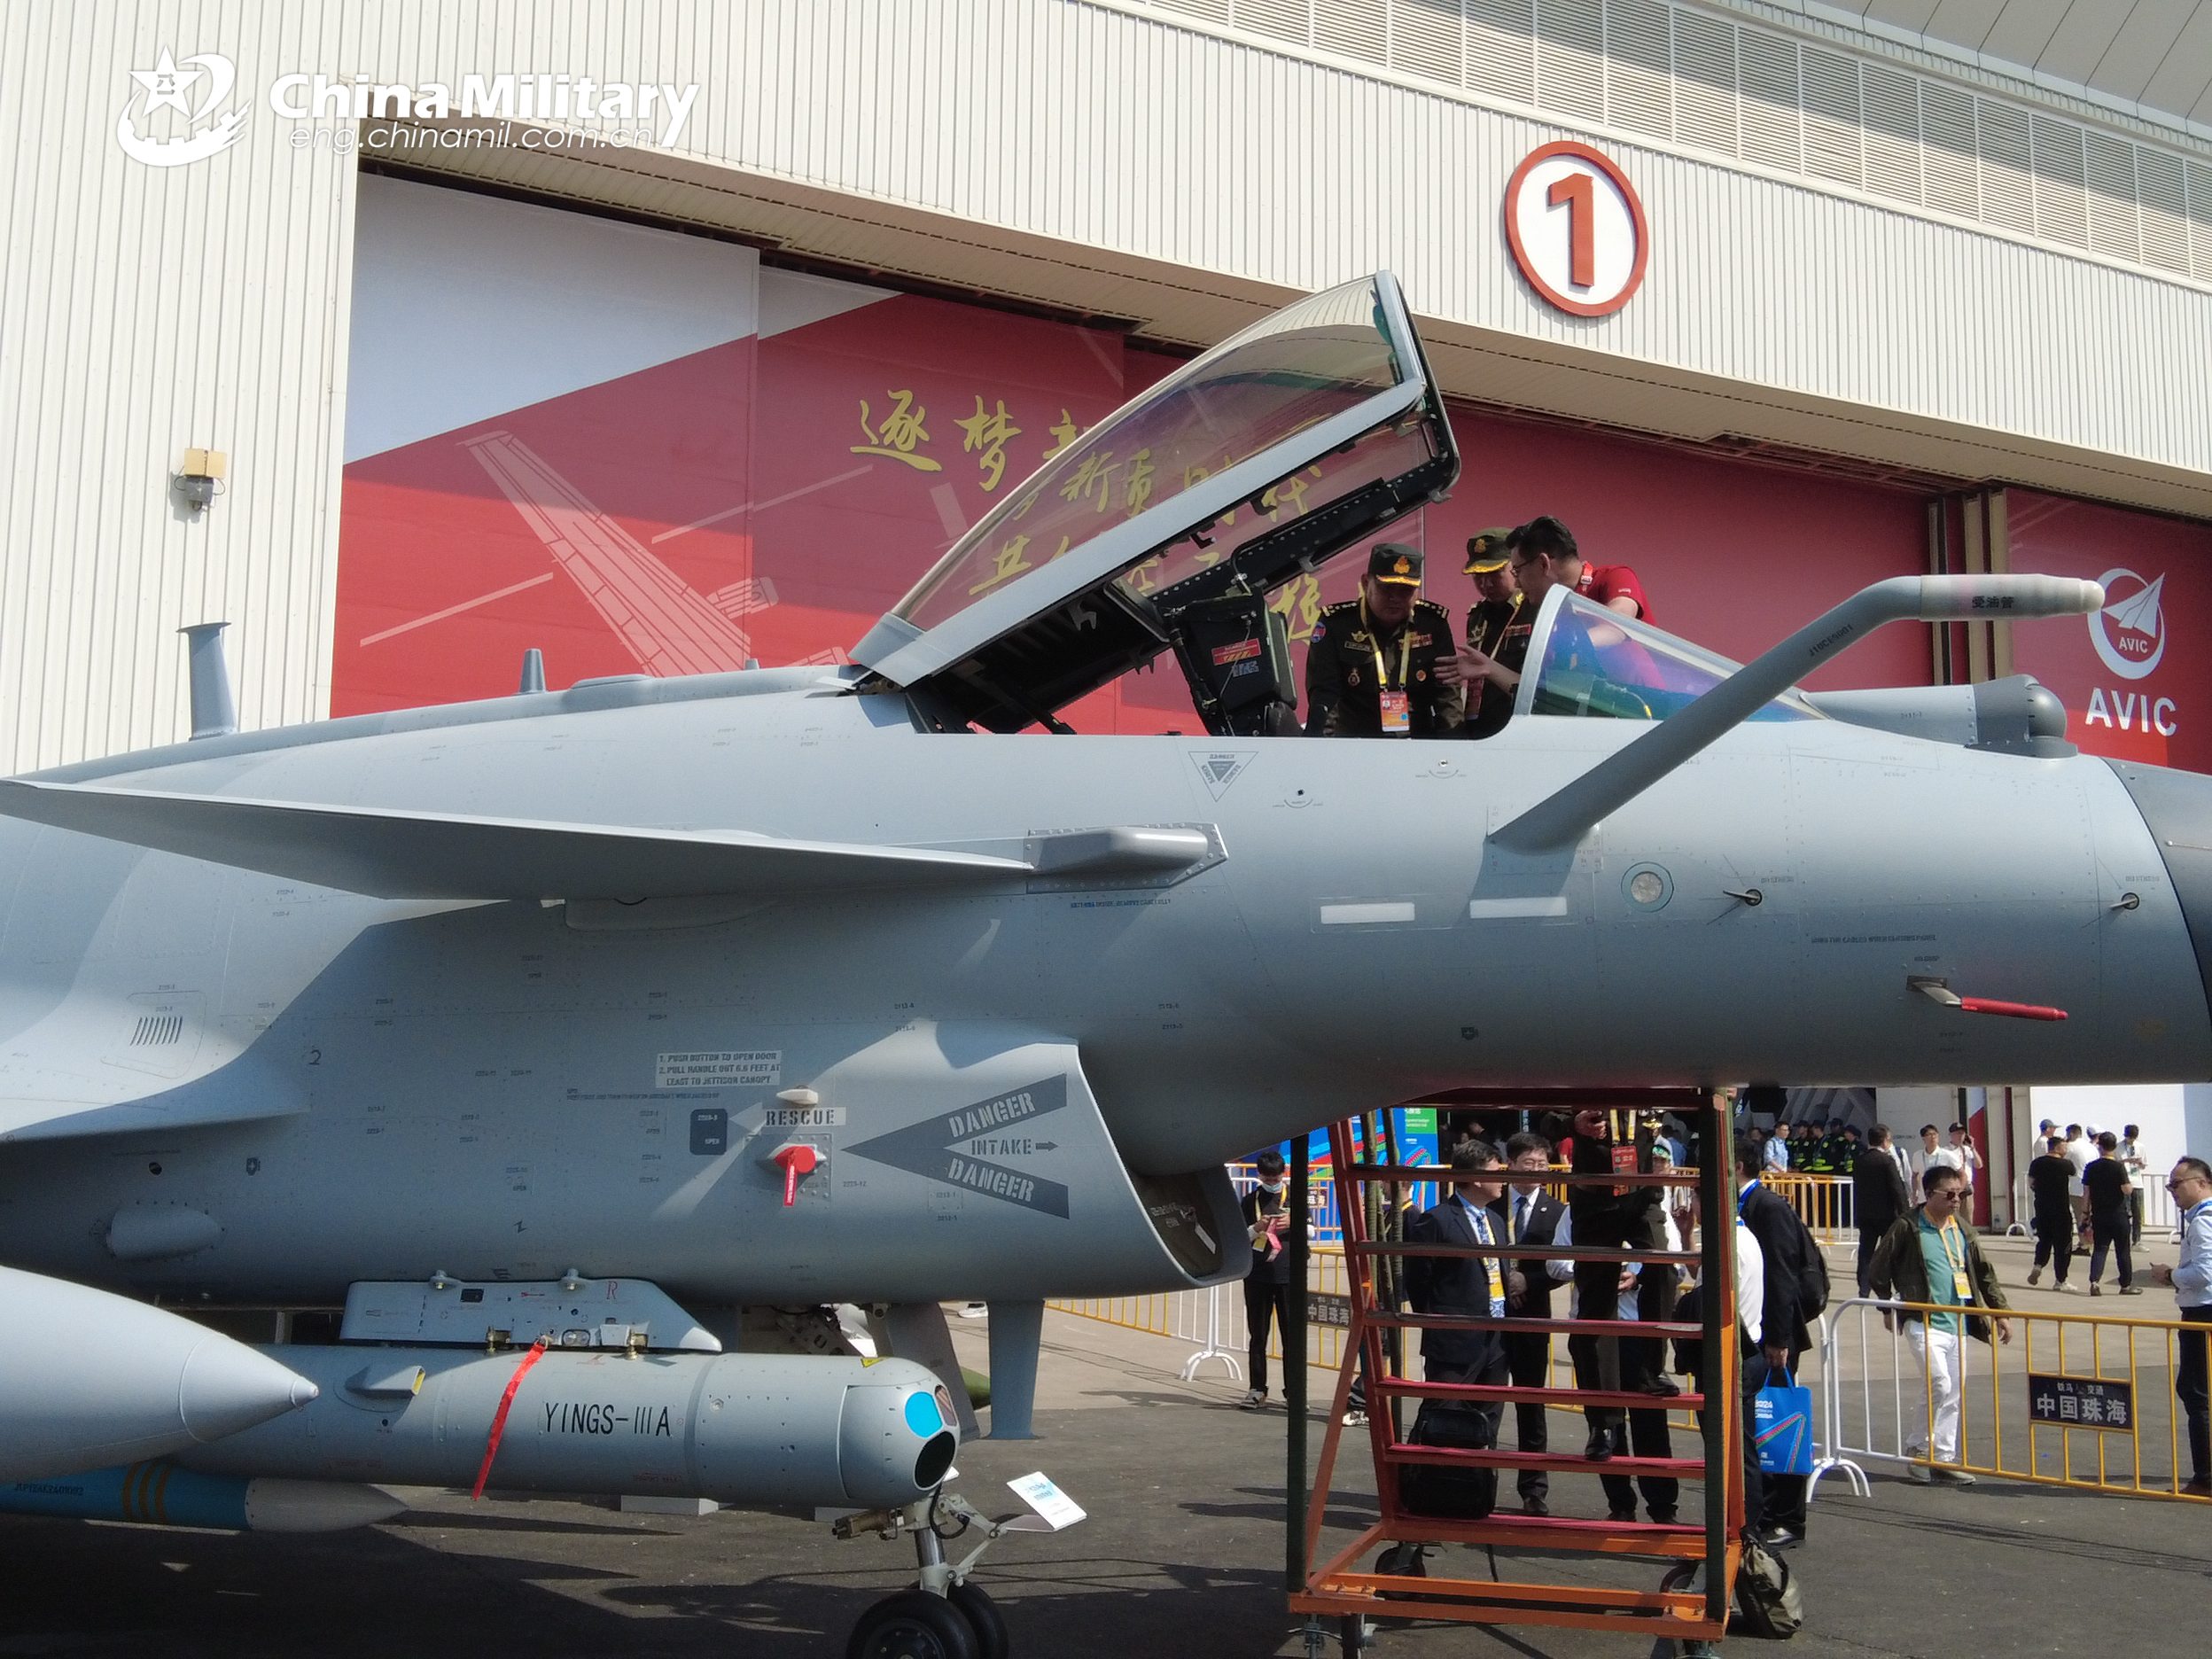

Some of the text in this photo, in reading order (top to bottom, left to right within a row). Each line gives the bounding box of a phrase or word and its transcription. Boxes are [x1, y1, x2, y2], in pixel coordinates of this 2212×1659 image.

[1548, 173, 1595, 288] 1
[2119, 636, 2148, 654] AVIC
[2085, 688, 2177, 736] AVIC
[691, 1077, 701, 1086] TO
[740, 1075, 771, 1084] CANOPY
[766, 1110, 835, 1126] RESCUE
[948, 1092, 1036, 1138] DANGER
[971, 1139, 1032, 1155] INTAKE
[947, 1157, 1035, 1203] DANGER
[2037, 1392, 2127, 1424] 中国珠海
